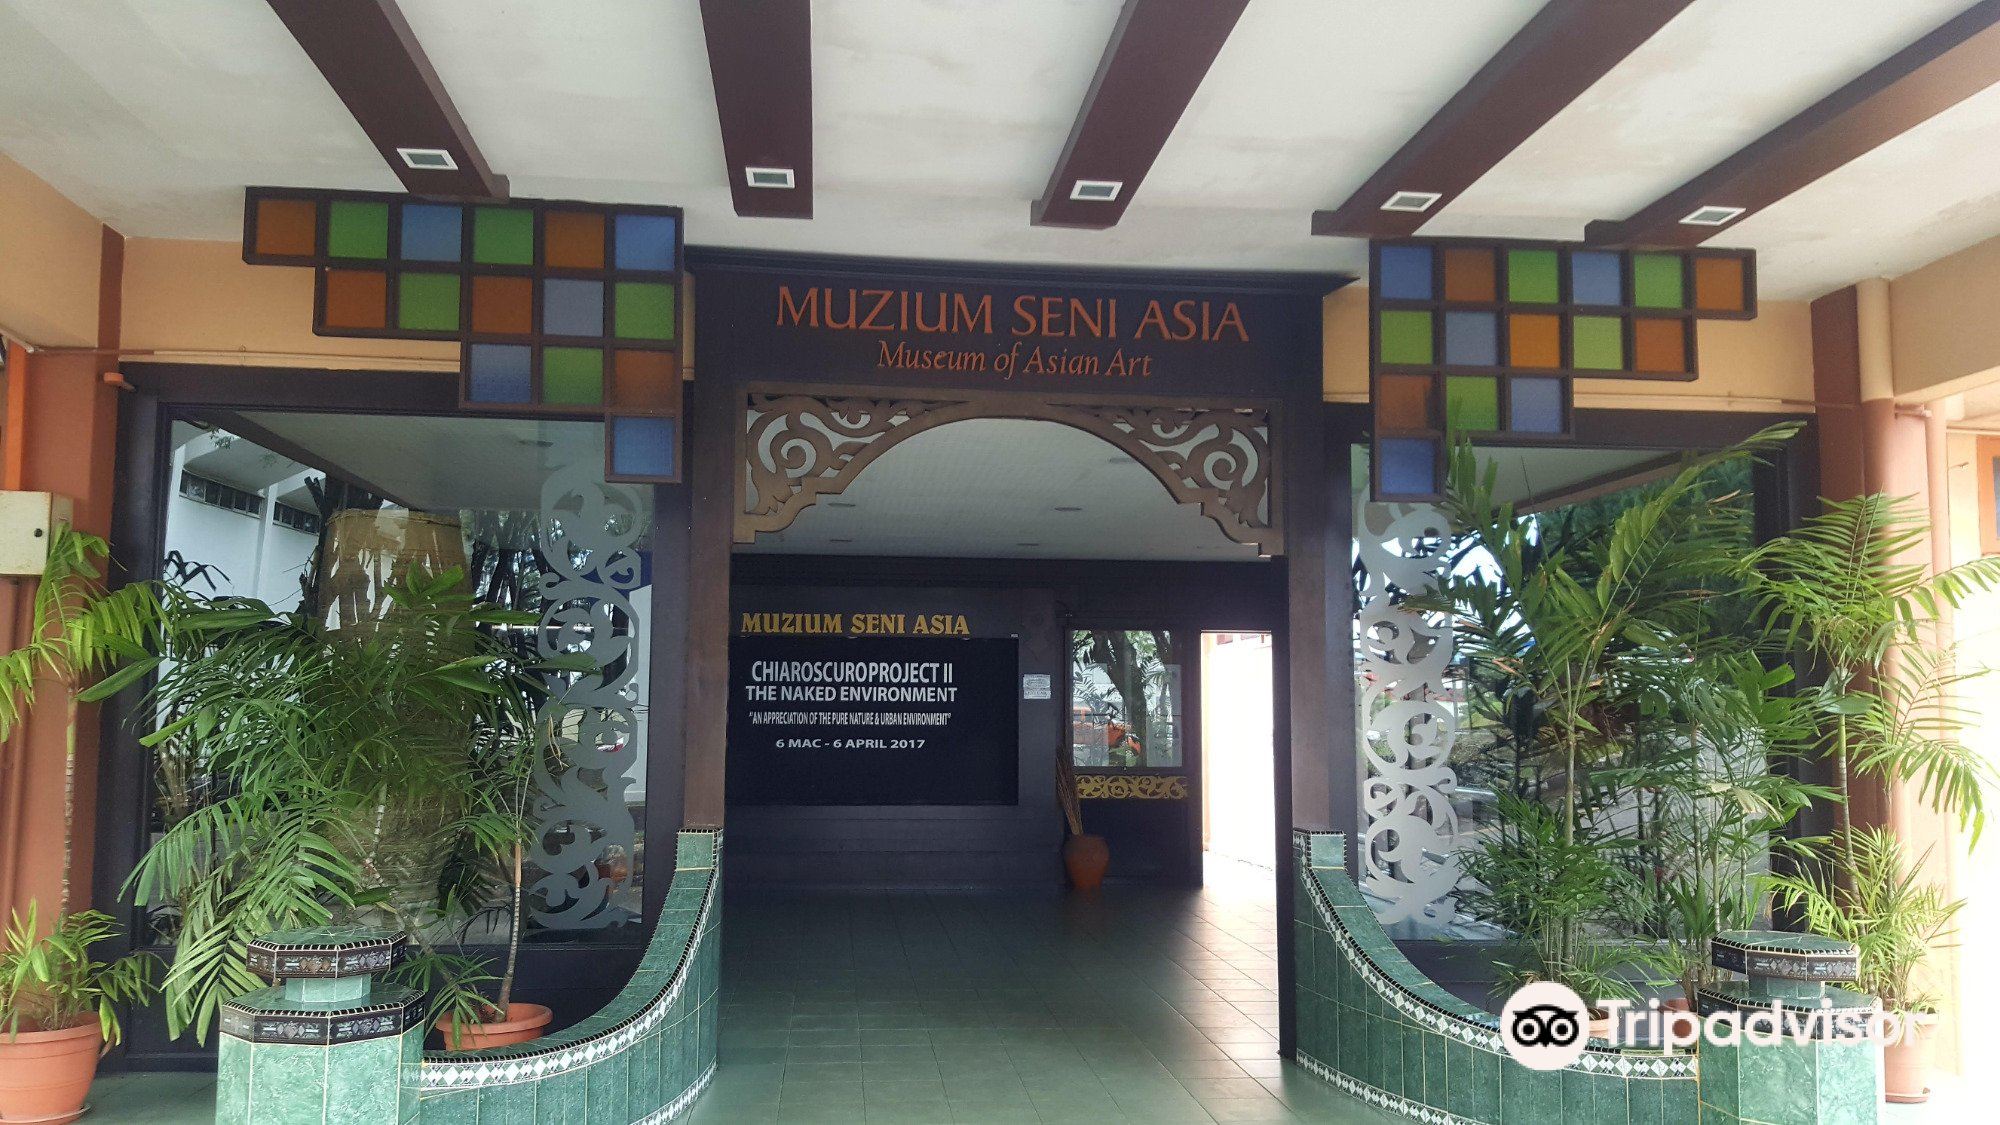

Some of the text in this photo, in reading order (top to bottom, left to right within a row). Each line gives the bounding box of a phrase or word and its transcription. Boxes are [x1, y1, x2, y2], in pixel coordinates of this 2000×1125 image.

[776, 285, 1251, 343] MUZIUM SENI ASIA
[877, 340, 1153, 381] Museum of Asian Art
[741, 612, 970, 636] MUZIUM SENI ASIA
[751, 660, 953, 684] CHIAROSCUROPROJECT II
[745, 685, 958, 702] THE NAKED ENVIRONMENT
[763, 711, 808, 725] APPRECIATION
[809, 712, 818, 725] OF
[819, 712, 832, 725] THE
[832, 712, 849, 725] PURE
[849, 712, 874, 726] NATURE
[875, 712, 880, 726] &
[880, 712, 903, 726] URBAN
[776, 739, 785, 748] 6
[788, 739, 822, 748] MAC
[833, 739, 842, 748] 6
[845, 739, 887, 749] APRIL
[890, 739, 926, 749] 2017
